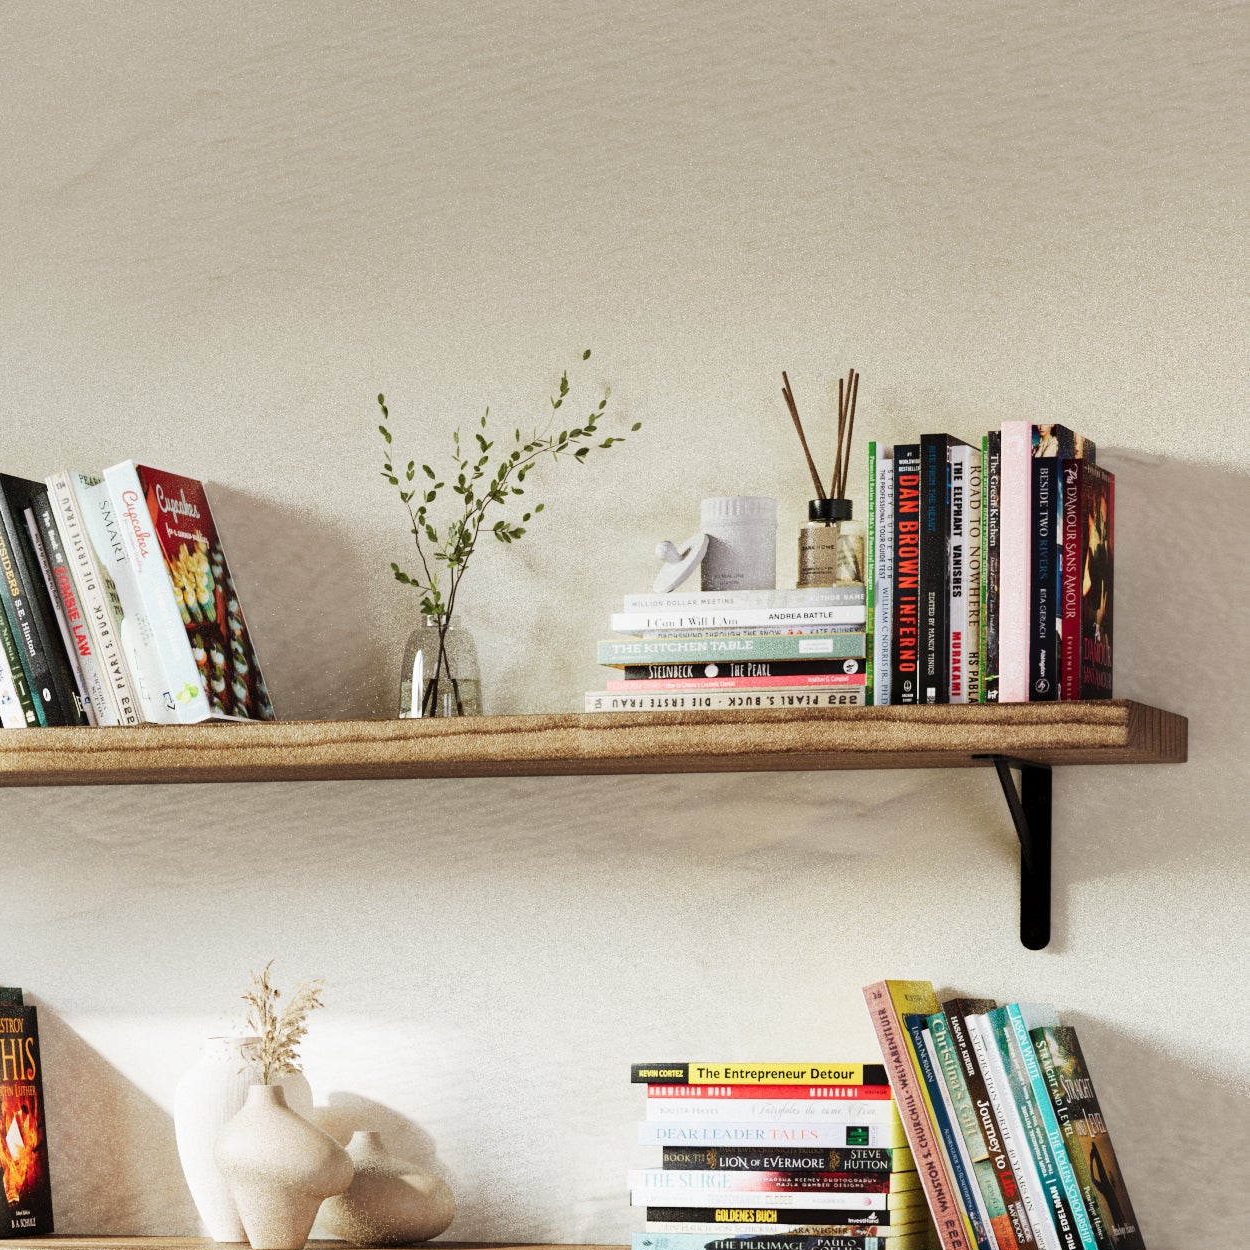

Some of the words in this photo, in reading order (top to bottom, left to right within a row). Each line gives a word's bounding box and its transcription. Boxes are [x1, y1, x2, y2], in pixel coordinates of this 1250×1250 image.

[953, 461, 963, 482] THE
[989, 453, 1000, 475] The
[886, 469, 894, 507] STUDY
[898, 474, 920, 514] DAN
[969, 465, 982, 510] ROAD
[989, 475, 1000, 509] Green
[1039, 467, 1050, 508] BESIDE
[61, 497, 78, 529] FRAU
[155, 483, 201, 524] Cupcakes
[953, 486, 963, 538] ELEPHANT
[1064, 486, 1079, 542] D'AMOUR
[121, 490, 151, 559] Cupcakes
[886, 513, 894, 550] GUIDE
[969, 516, 982, 539] TO
[989, 508, 1000, 548] Kitchen
[1039, 508, 1050, 538] TWO
[71, 533, 90, 567] ERSTE
[898, 520, 920, 589] BROWN
[1039, 539, 1050, 581] RIVERS
[1064, 542, 1079, 573] SANS
[83, 571, 97, 592] DIE
[886, 559, 894, 579] FOR
[953, 544, 963, 599] VANISHES
[632, 599, 663, 608] MILLION
[666, 598, 697, 607] DOLLAR
[843, 592, 865, 601] NAME
[969, 546, 982, 628] NOWHERE
[1064, 573, 1079, 620] AMOUR
[54, 565, 80, 622] ZOMBIE
[72, 625, 92, 657] LAW
[768, 611, 802, 621] ANDREA
[803, 610, 834, 620] BATTLE
[881, 587, 889, 623] WILLIAM
[928, 592, 936, 617] EDITED
[14, 599, 26, 621] S.E.
[21, 622, 37, 657] Hinton
[93, 604, 110, 637] BUCK
[881, 625, 889, 633] C
[898, 596, 920, 673] INFERNO
[928, 617, 936, 627] BY
[1039, 605, 1047, 640] GERLACH
[2, 628, 15, 662] NARNIA
[611, 642, 643, 655] THE
[645, 641, 710, 654] KITCHEN
[711, 640, 754, 652] TABLE
[881, 634, 889, 667] NORRIS
[928, 628, 936, 652] MANDY
[107, 653, 126, 690] PEARL
[649, 665, 694, 679] STEINBECK
[951, 631, 962, 698] MURAKAMI
[968, 651, 979, 667] HS
[1038, 648, 1048, 679] Abingdon
[18, 680, 26, 696] 1
[612, 699, 643, 708] FRAU
[649, 698, 685, 708] ERSTE
[692, 697, 712, 707] DIE
[728, 697, 761, 707] BUCK
[766, 695, 775, 706] S.
[780, 695, 820, 706] PEARL
[911, 1025, 924, 1051] LINDA
[950, 1015, 964, 1042] HASAN
[877, 1007, 909, 1090] WELTABENTEUER
[932, 1018, 963, 1100] Christina's
[1009, 1015, 1029, 1047] JASON
[1024, 1047, 1040, 1081] WHITE
[638, 1070, 659, 1078] KEVIN
[658, 1069, 684, 1078] CORTEZ
[696, 1067, 720, 1080] The
[724, 1067, 806, 1082] Entrepreneur
[810, 1068, 855, 1080] Detour
[916, 1049, 934, 1083] NORMAN
[970, 1027, 1000, 1101] EXPLORATION
[1036, 1039, 1057, 1089] STRAIGHT
[14, 1084, 37, 1098] LUTHER
[649, 1086, 702, 1097] NORWEGIAN
[707, 1086, 733, 1097] WOOD
[809, 1087, 859, 1098] MURAKAMI
[1051, 1087, 1062, 1106] AND
[656, 1129, 700, 1141] DEAR
[702, 1129, 765, 1141] LEADER
[772, 1129, 820, 1141] TALES
[903, 1092, 929, 1149] CHURCHILL
[976, 1100, 1001, 1154] Journey
[1056, 1106, 1074, 1138] LEVEL
[663, 1153, 691, 1162] BOOK
[719, 1156, 749, 1169] LION
[763, 1155, 826, 1169] EVERMORE
[844, 1160, 889, 1170] HUTTON
[850, 1149, 882, 1159] STEVE
[994, 1154, 1007, 1170] to
[679, 1173, 732, 1188] SURGE
[926, 1161, 949, 1214] WINSTON
[999, 1170, 1018, 1198] Life
[1050, 1130, 1061, 1149] THE
[1056, 1148, 1073, 1184] POLLEN
[1068, 1183, 1092, 1243] SCHOLARSHIP
[20, 1217, 37, 1228] SCHULZ
[715, 1209, 755, 1222] GOLDENES
[756, 1209, 778, 1222] BUCH
[1050, 1185, 1070, 1232] EDELMAN
[714, 1240, 737, 1250] THE
[788, 1227, 812, 1235] LARA
[812, 1227, 849, 1235] WEGNER
[1064, 1232, 1076, 1250] RIC
